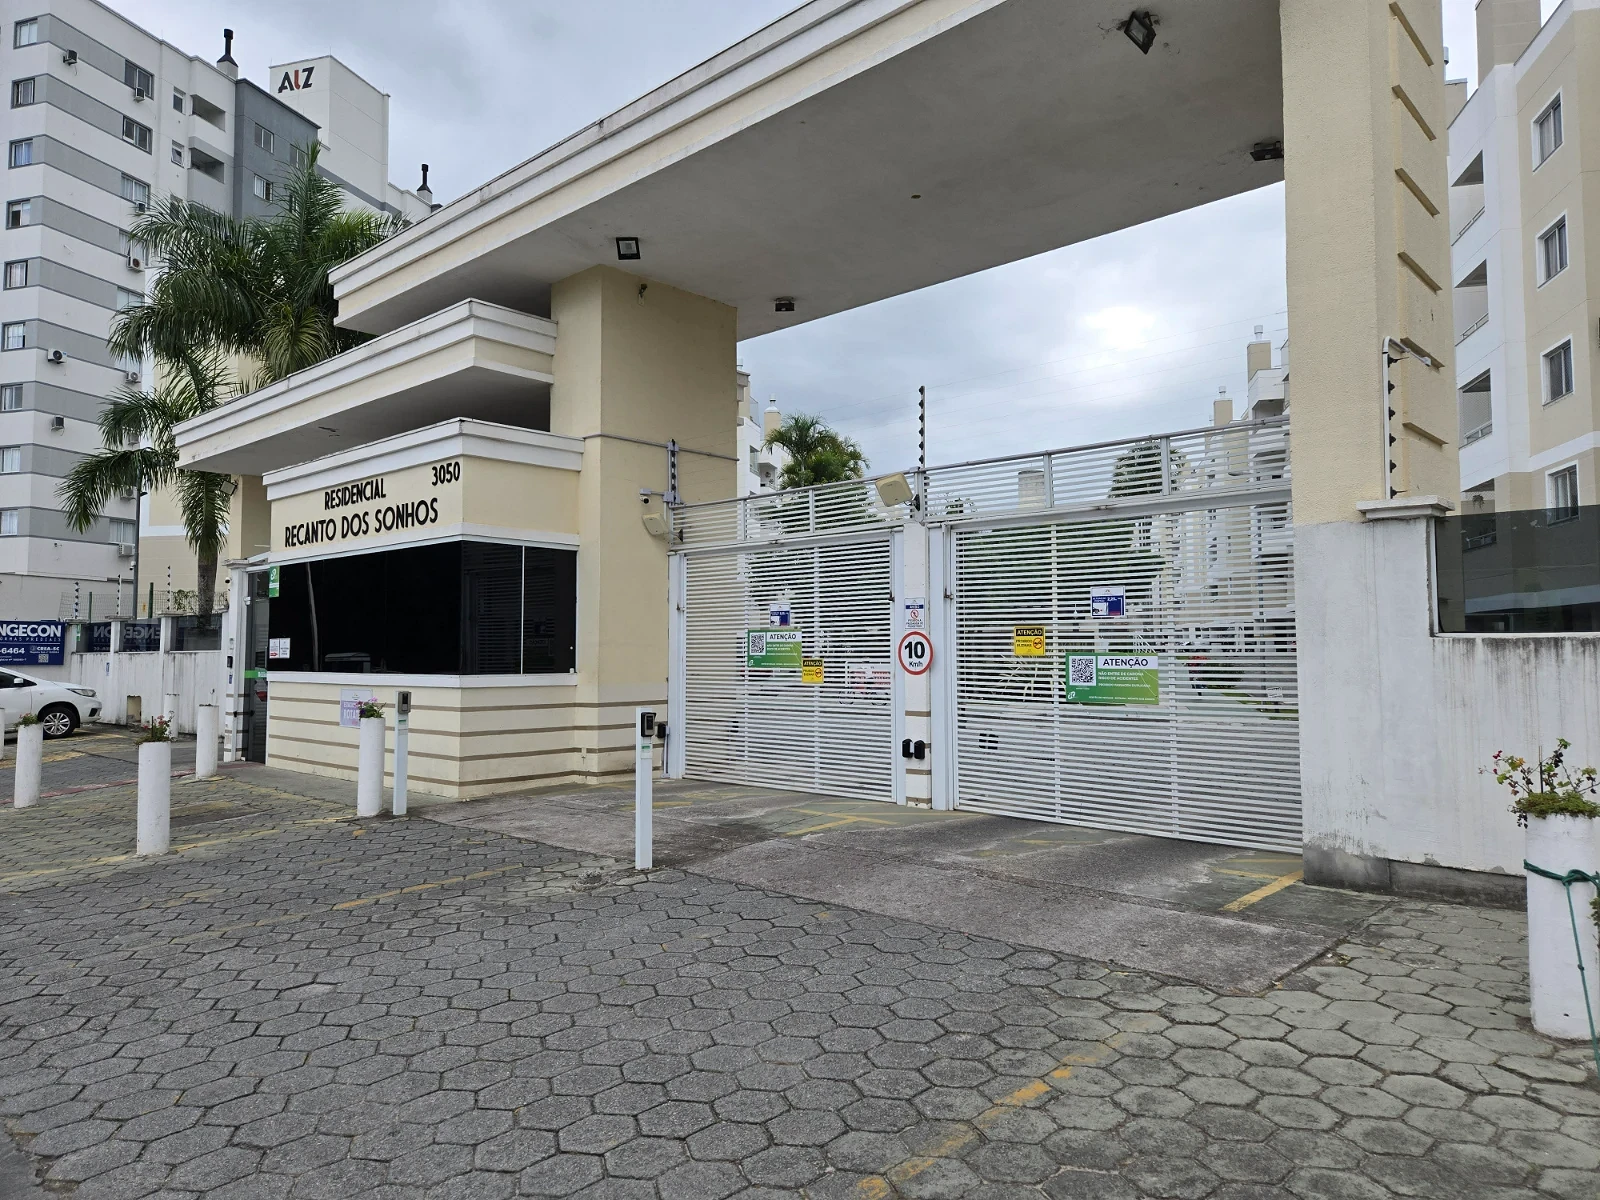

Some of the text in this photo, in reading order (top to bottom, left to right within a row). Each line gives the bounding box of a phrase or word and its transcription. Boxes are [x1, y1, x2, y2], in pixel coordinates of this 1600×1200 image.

[432, 461, 460, 486] 3050
[324, 478, 386, 510] RESIDENCIAL
[285, 497, 438, 548] RECANTO DOS SONHOS
[770, 633, 797, 641] ATENÇÃO
[1017, 628, 1042, 636] ATENÇÃO
[904, 641, 925, 659] 10
[1102, 657, 1149, 669] ATENÇÃO
